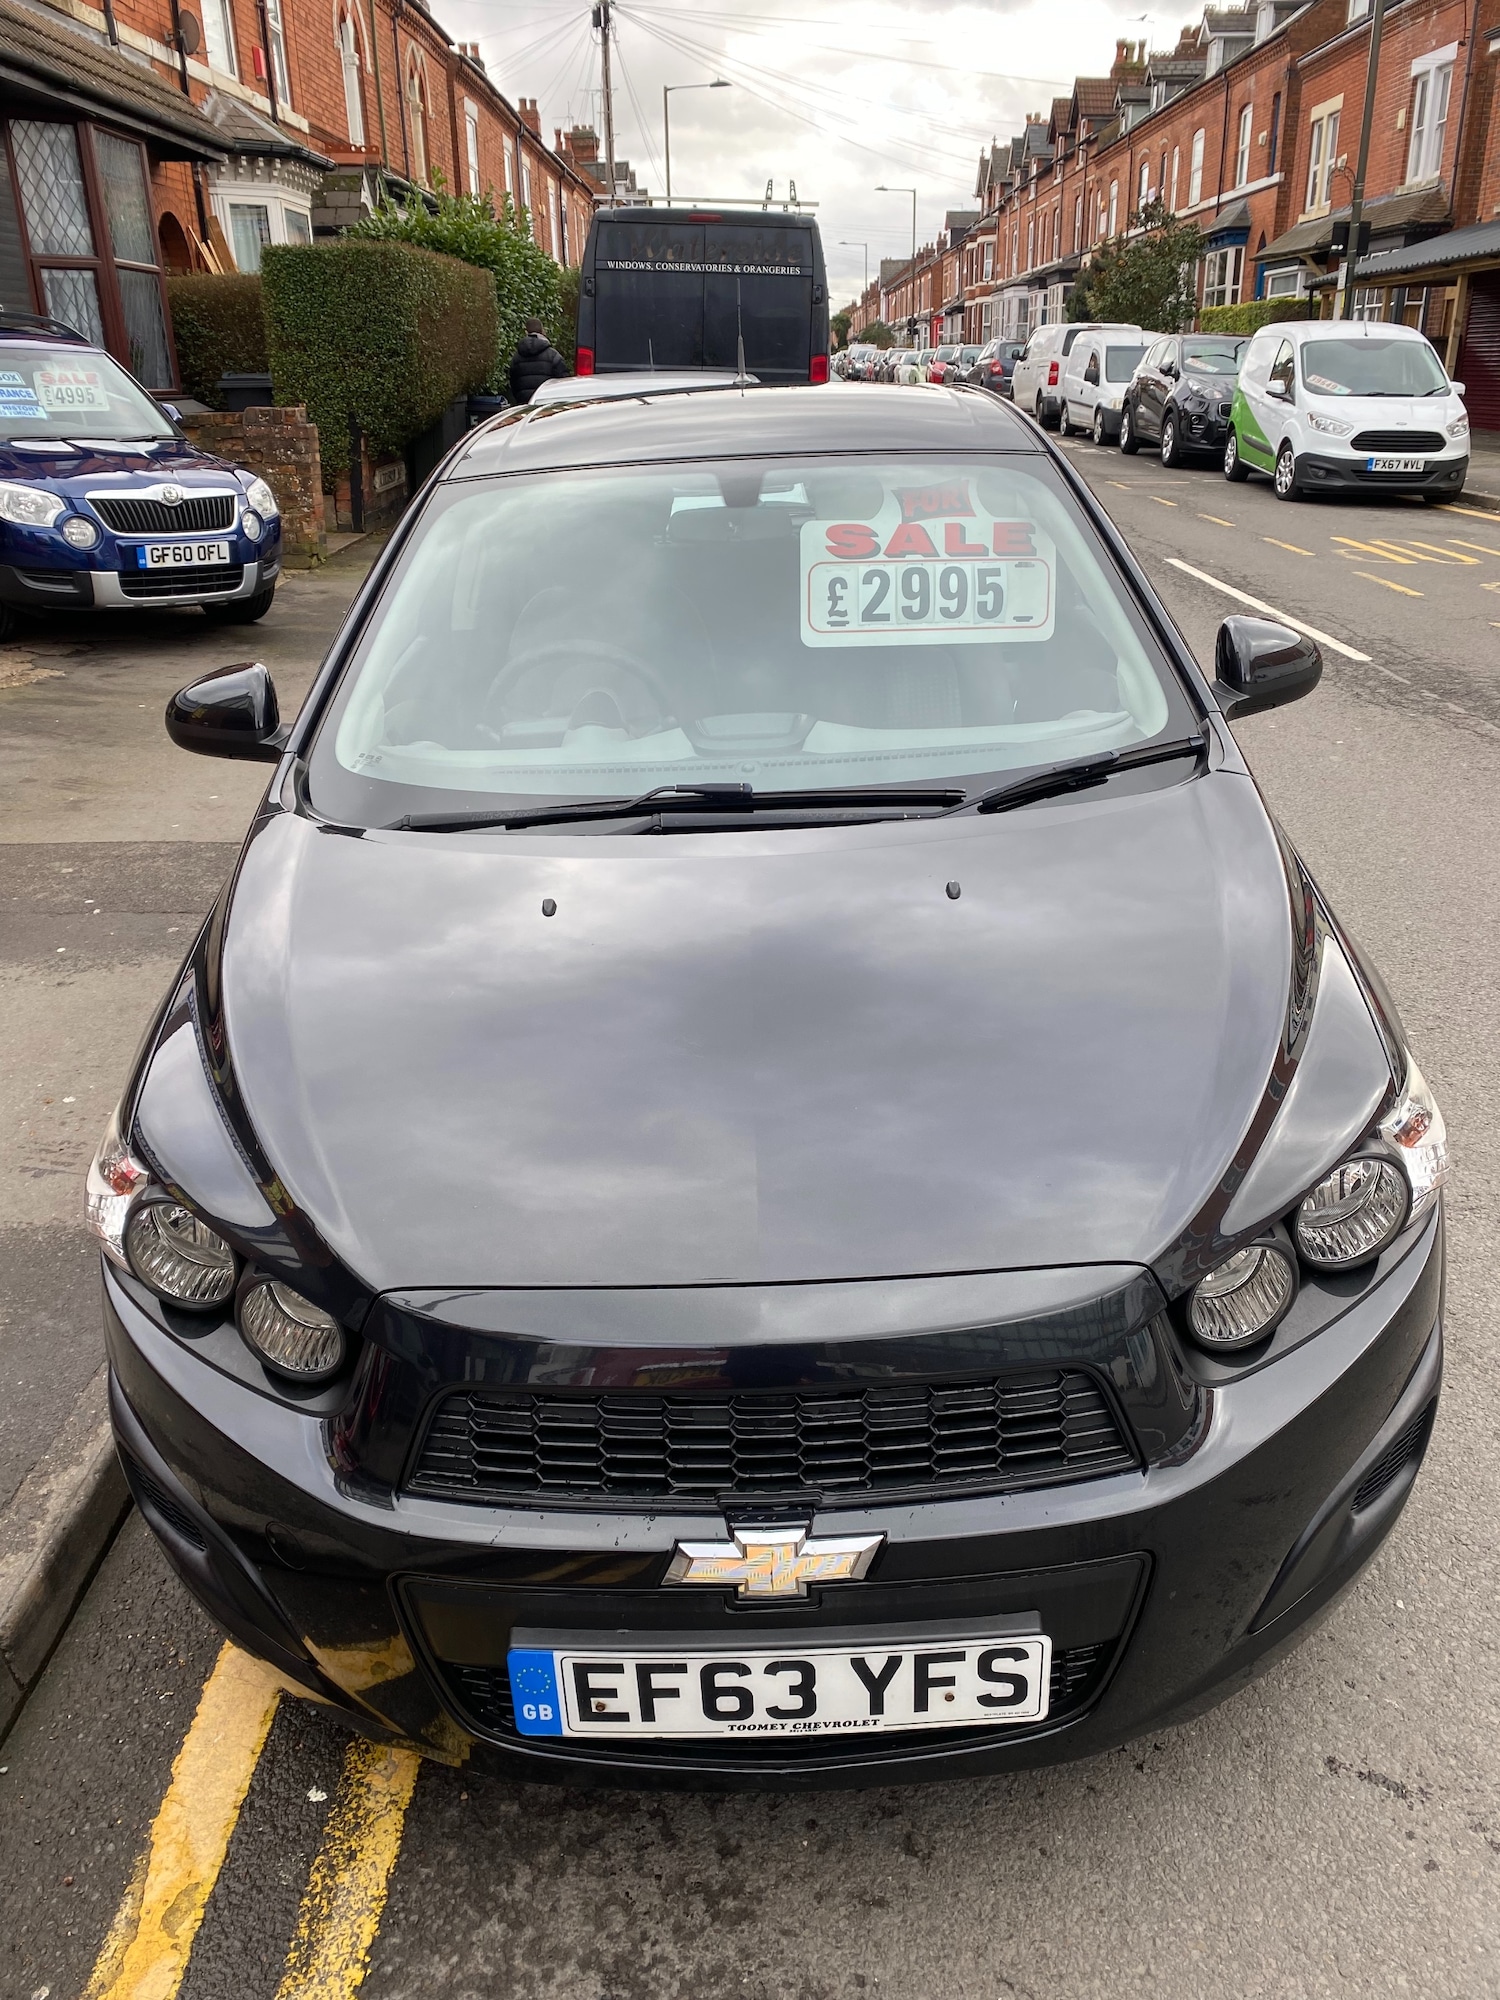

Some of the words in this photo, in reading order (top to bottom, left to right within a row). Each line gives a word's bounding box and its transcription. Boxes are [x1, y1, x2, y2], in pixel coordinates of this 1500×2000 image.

[655, 262, 733, 273] CONSERVATORIES
[734, 264, 741, 273] &
[743, 265, 801, 275] ORANGERIES
[40, 372, 99, 385] SALE
[1374, 460, 1401, 470] FX67
[1403, 460, 1422, 470] WVL
[903, 487, 962, 517] FOR
[825, 521, 1038, 560] SALE
[150, 545, 193, 564] GF60
[197, 544, 227, 561] OFL
[827, 566, 1004, 622] £2995
[571, 1659, 818, 1723] EF63
[849, 1646, 1031, 1716] YFS
[522, 1704, 554, 1721] GB
[727, 1722, 788, 1732] TOOMEY
[792, 1719, 880, 1730] CHEVROLET
